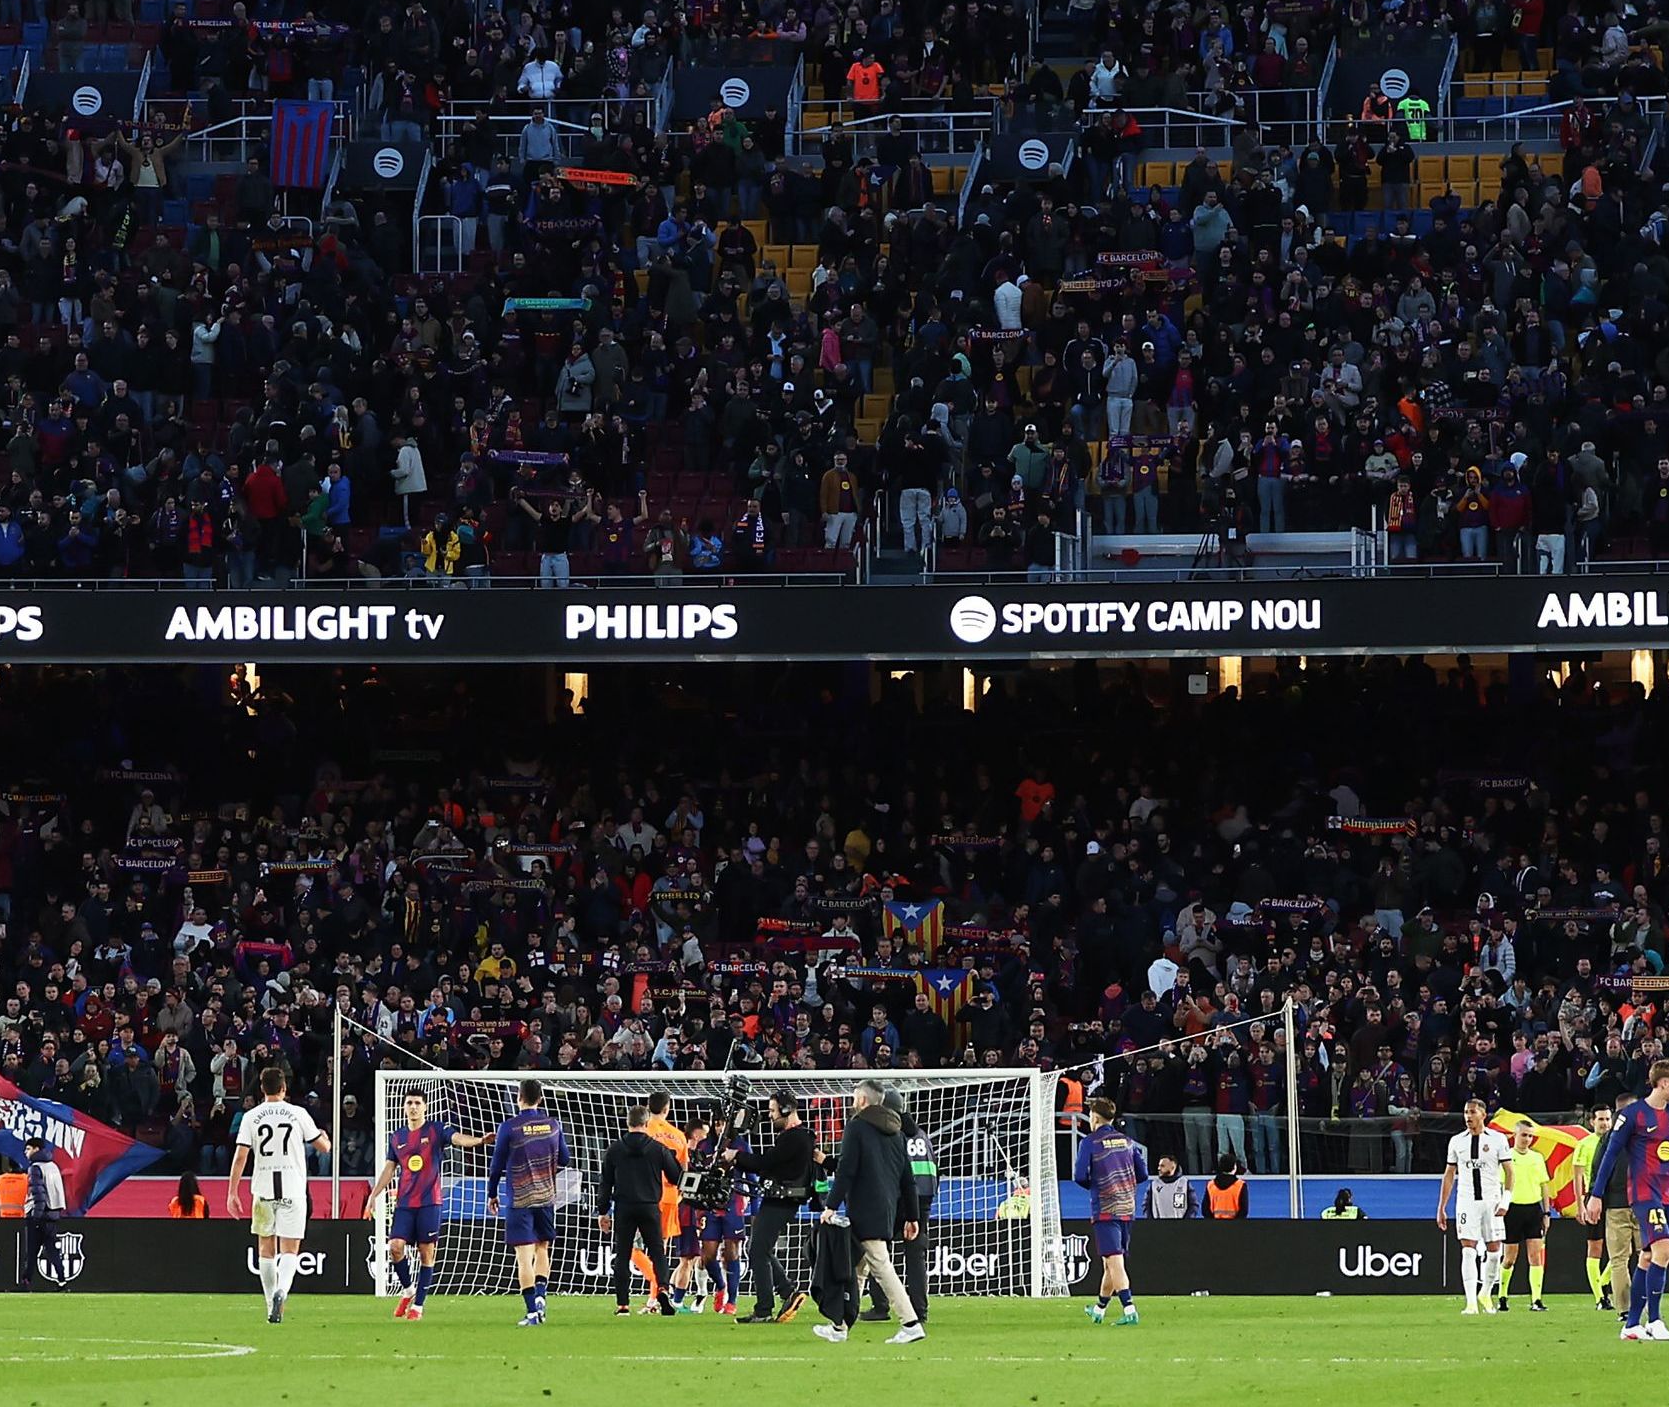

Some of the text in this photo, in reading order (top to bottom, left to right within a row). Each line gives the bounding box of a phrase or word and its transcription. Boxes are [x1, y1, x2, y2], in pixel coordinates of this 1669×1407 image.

[1110, 252, 1158, 262] BARCELONA
[165, 606, 444, 640] AMBILIGHT tv
[566, 604, 737, 639] PHILIPS
[1002, 600, 1320, 633] SPOTIFY CAMP NOU
[258, 1123, 293, 1156] 27
[1649, 1209, 1668, 1225] 43
[247, 1247, 326, 1276] Uer
[1340, 1246, 1422, 1276] Uber
